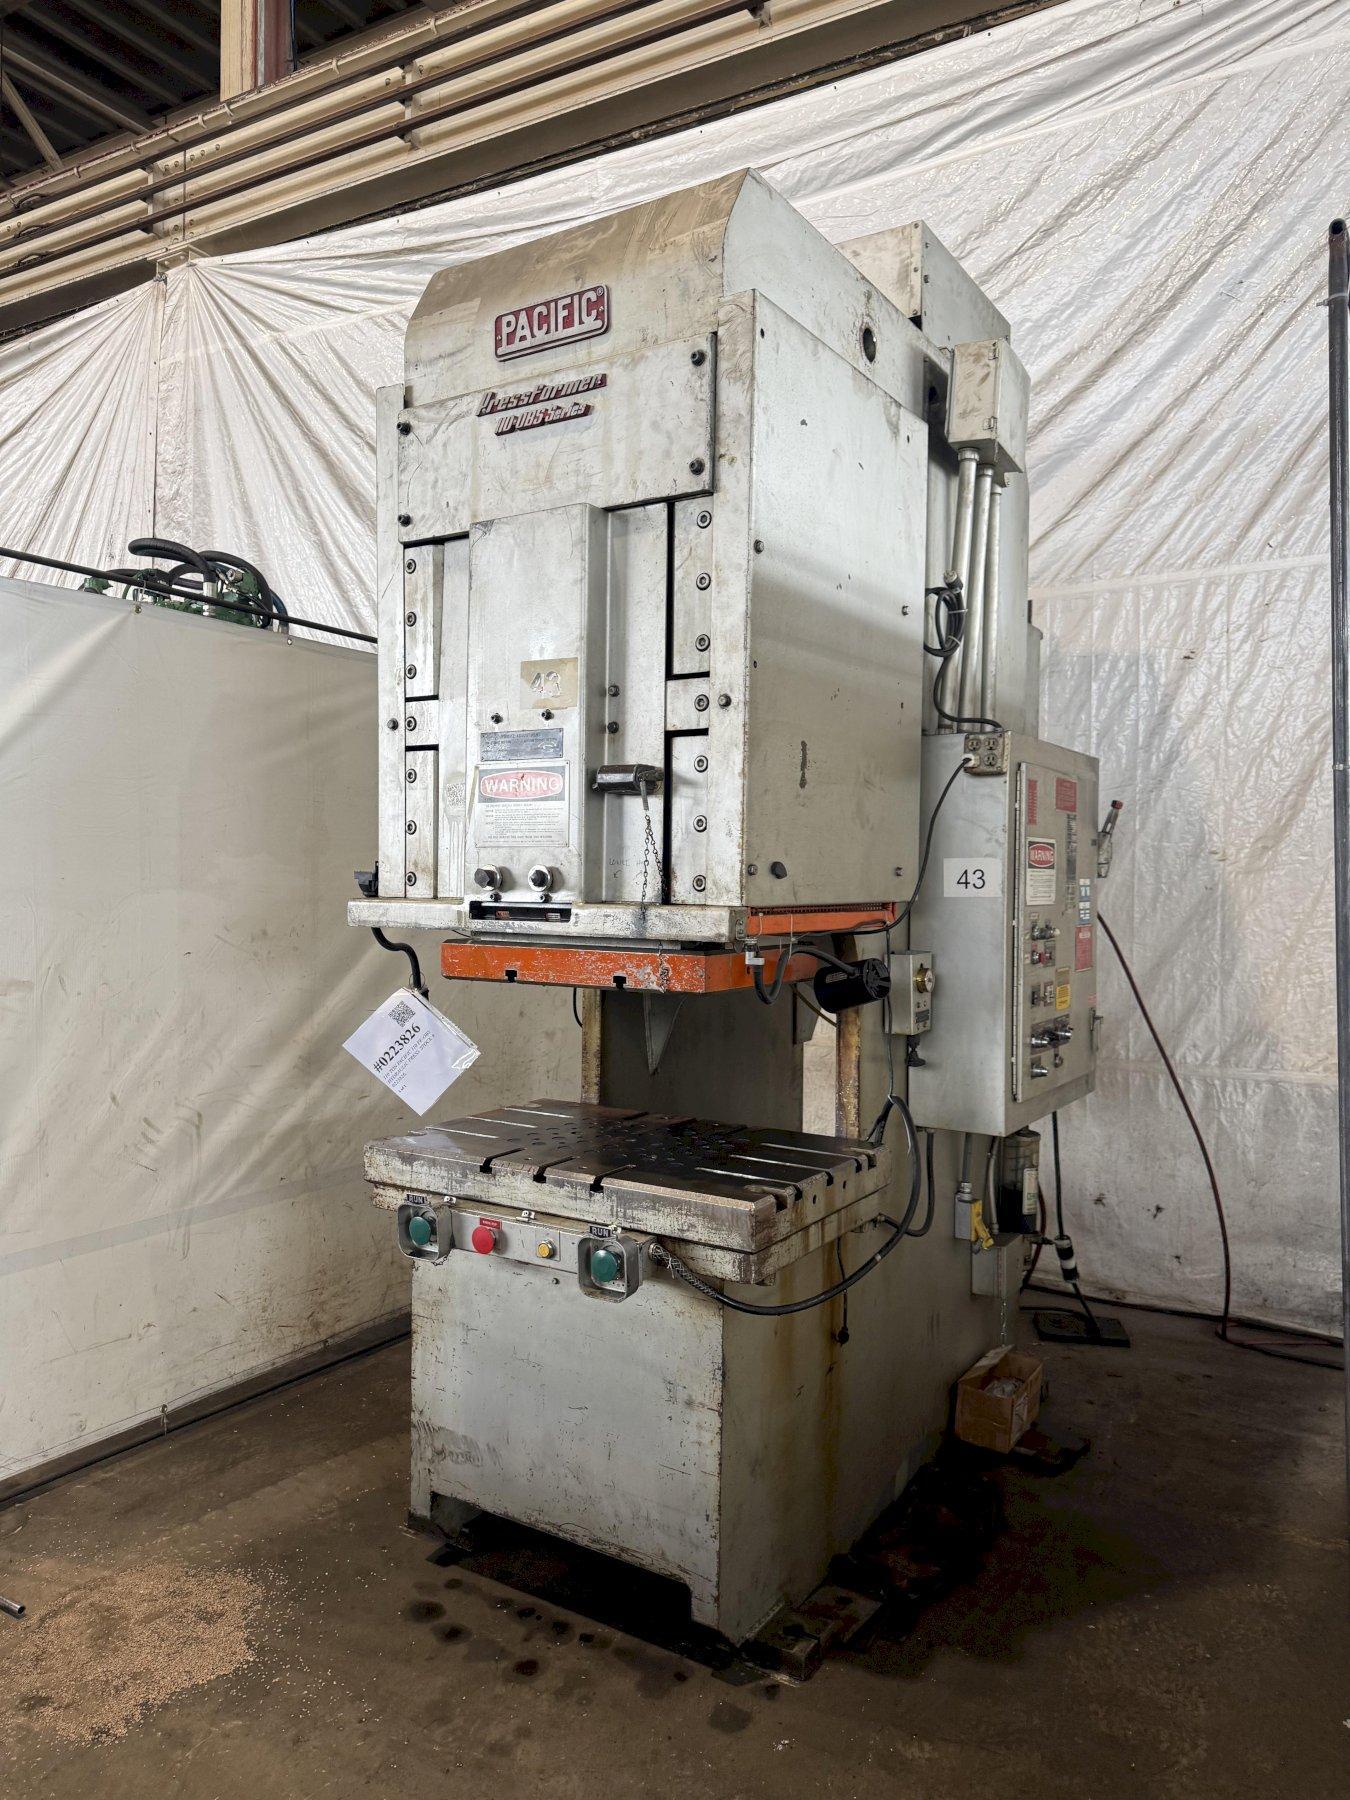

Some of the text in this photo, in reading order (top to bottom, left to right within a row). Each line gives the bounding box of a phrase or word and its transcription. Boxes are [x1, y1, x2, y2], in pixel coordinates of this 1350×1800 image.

[484, 777, 561, 793] WARNING
[1029, 850, 1055, 861] WARNING
[956, 868, 986, 890] 43
[374, 1023, 420, 1073] #0223826
[409, 1194, 423, 1204] RUN
[591, 1226, 608, 1237] RUN
